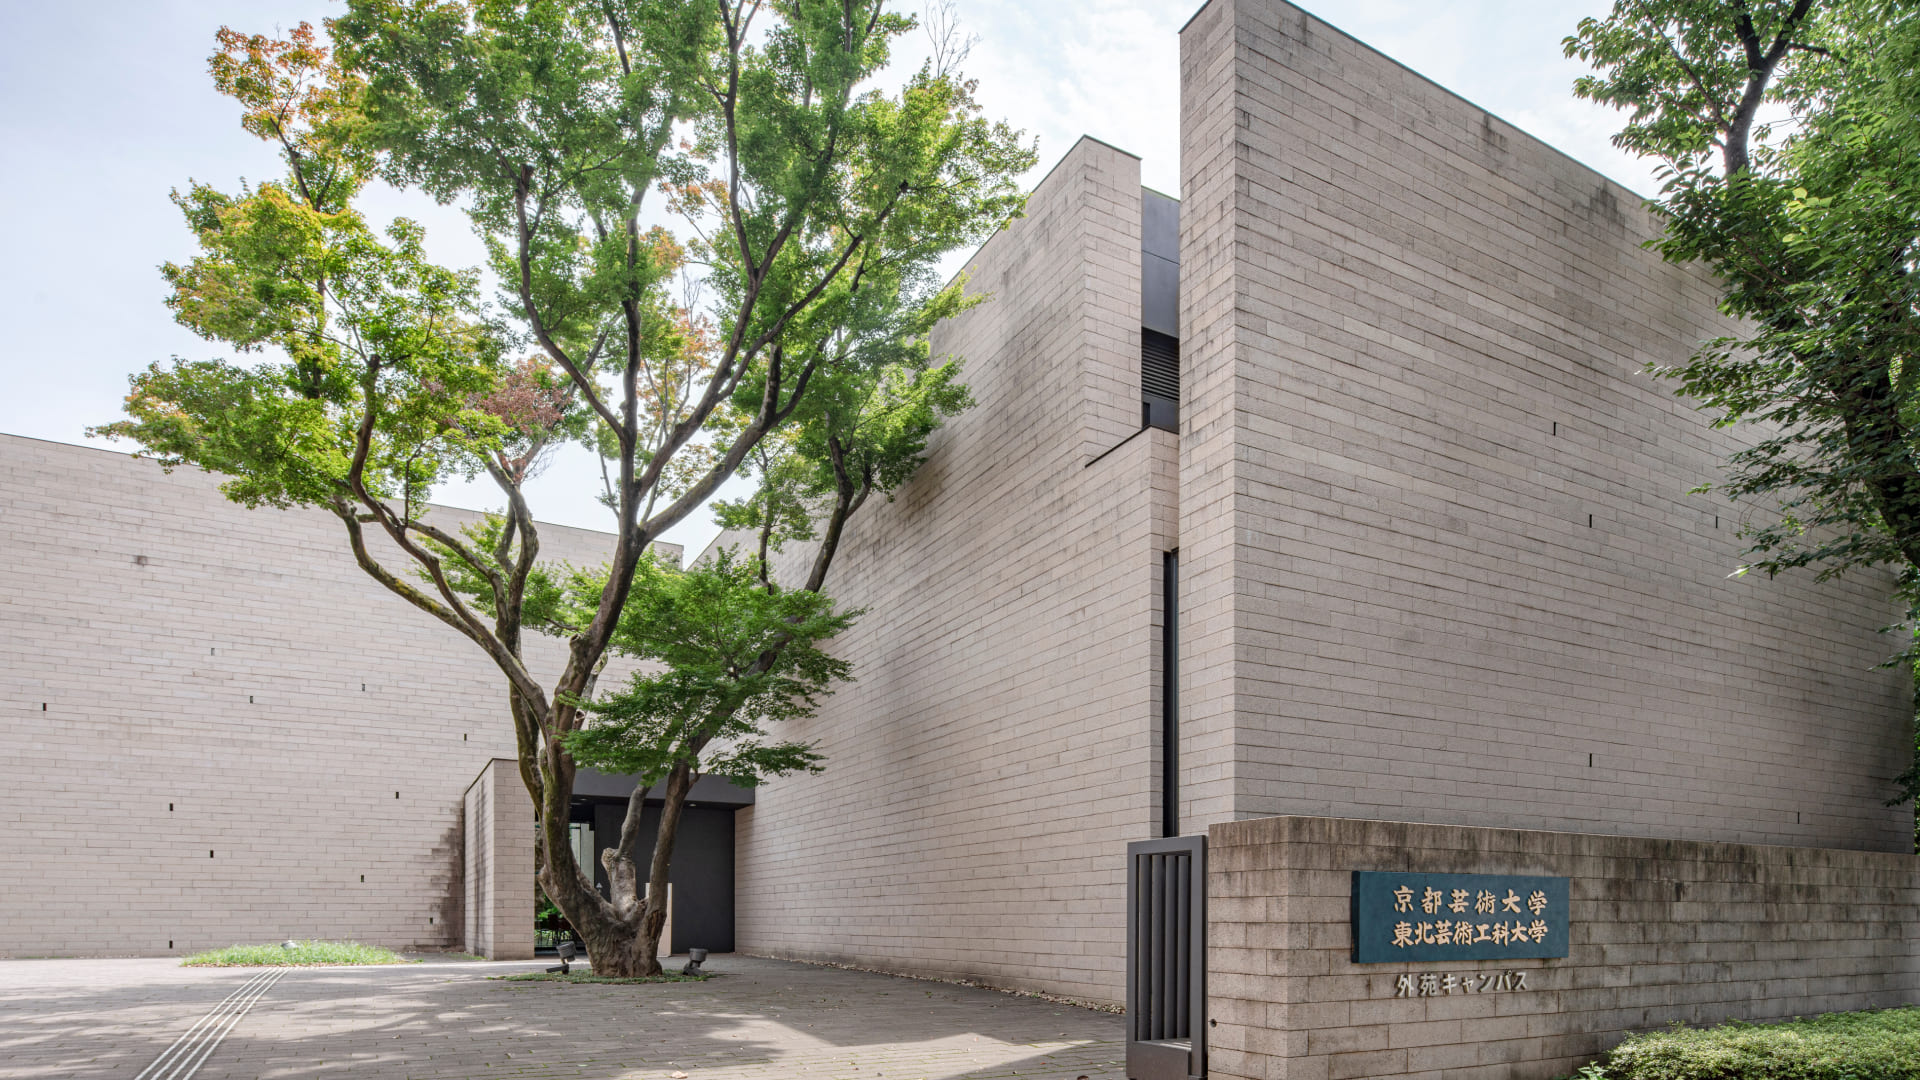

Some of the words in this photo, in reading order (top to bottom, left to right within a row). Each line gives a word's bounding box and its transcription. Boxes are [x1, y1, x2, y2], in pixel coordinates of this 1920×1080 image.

[1392, 885, 1548, 915] 京都芸術大学
[1391, 920, 1548, 948] 東北芸術工科大学
[1396, 970, 1528, 997] 外苑キャンパス
